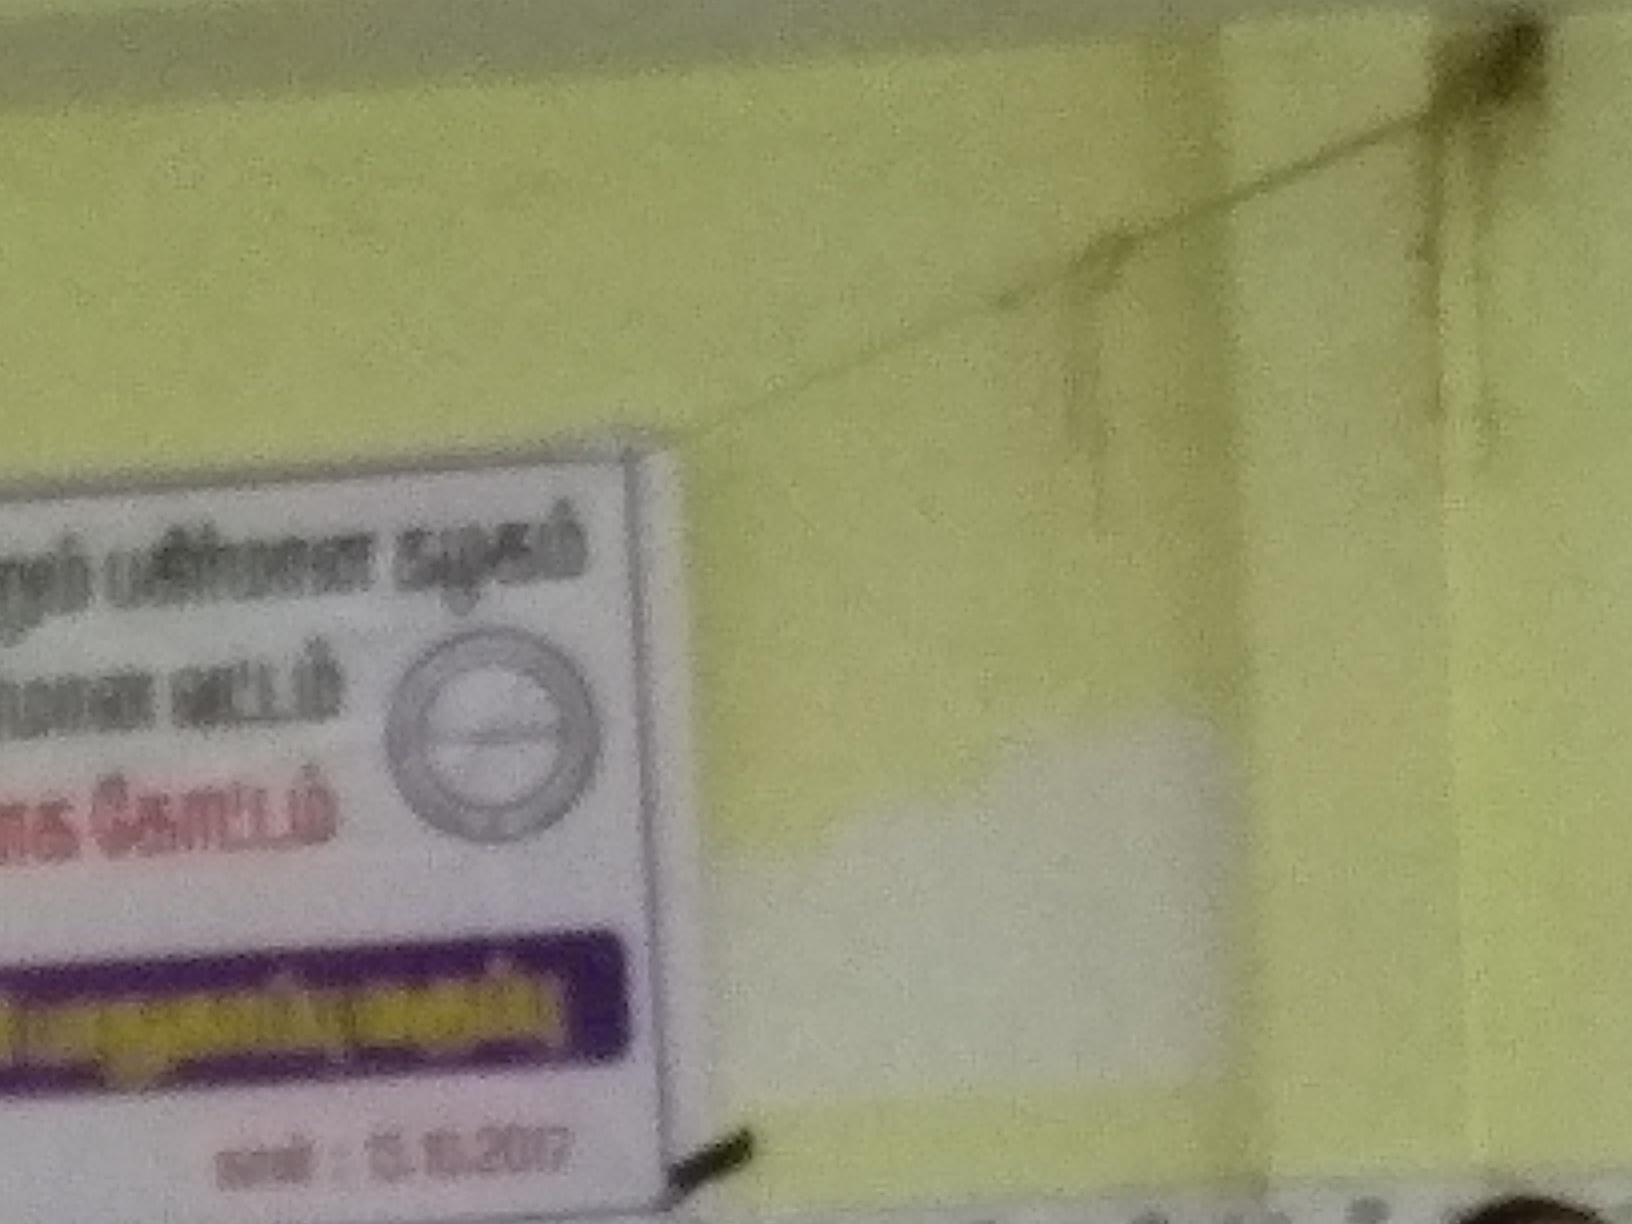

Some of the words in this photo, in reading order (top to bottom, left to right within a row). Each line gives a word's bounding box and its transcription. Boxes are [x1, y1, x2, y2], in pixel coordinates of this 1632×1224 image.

[392, 498, 588, 617] கழகம்
[171, 635, 345, 730] வட்டம்
[90, 762, 340, 864] கோட்டம்
